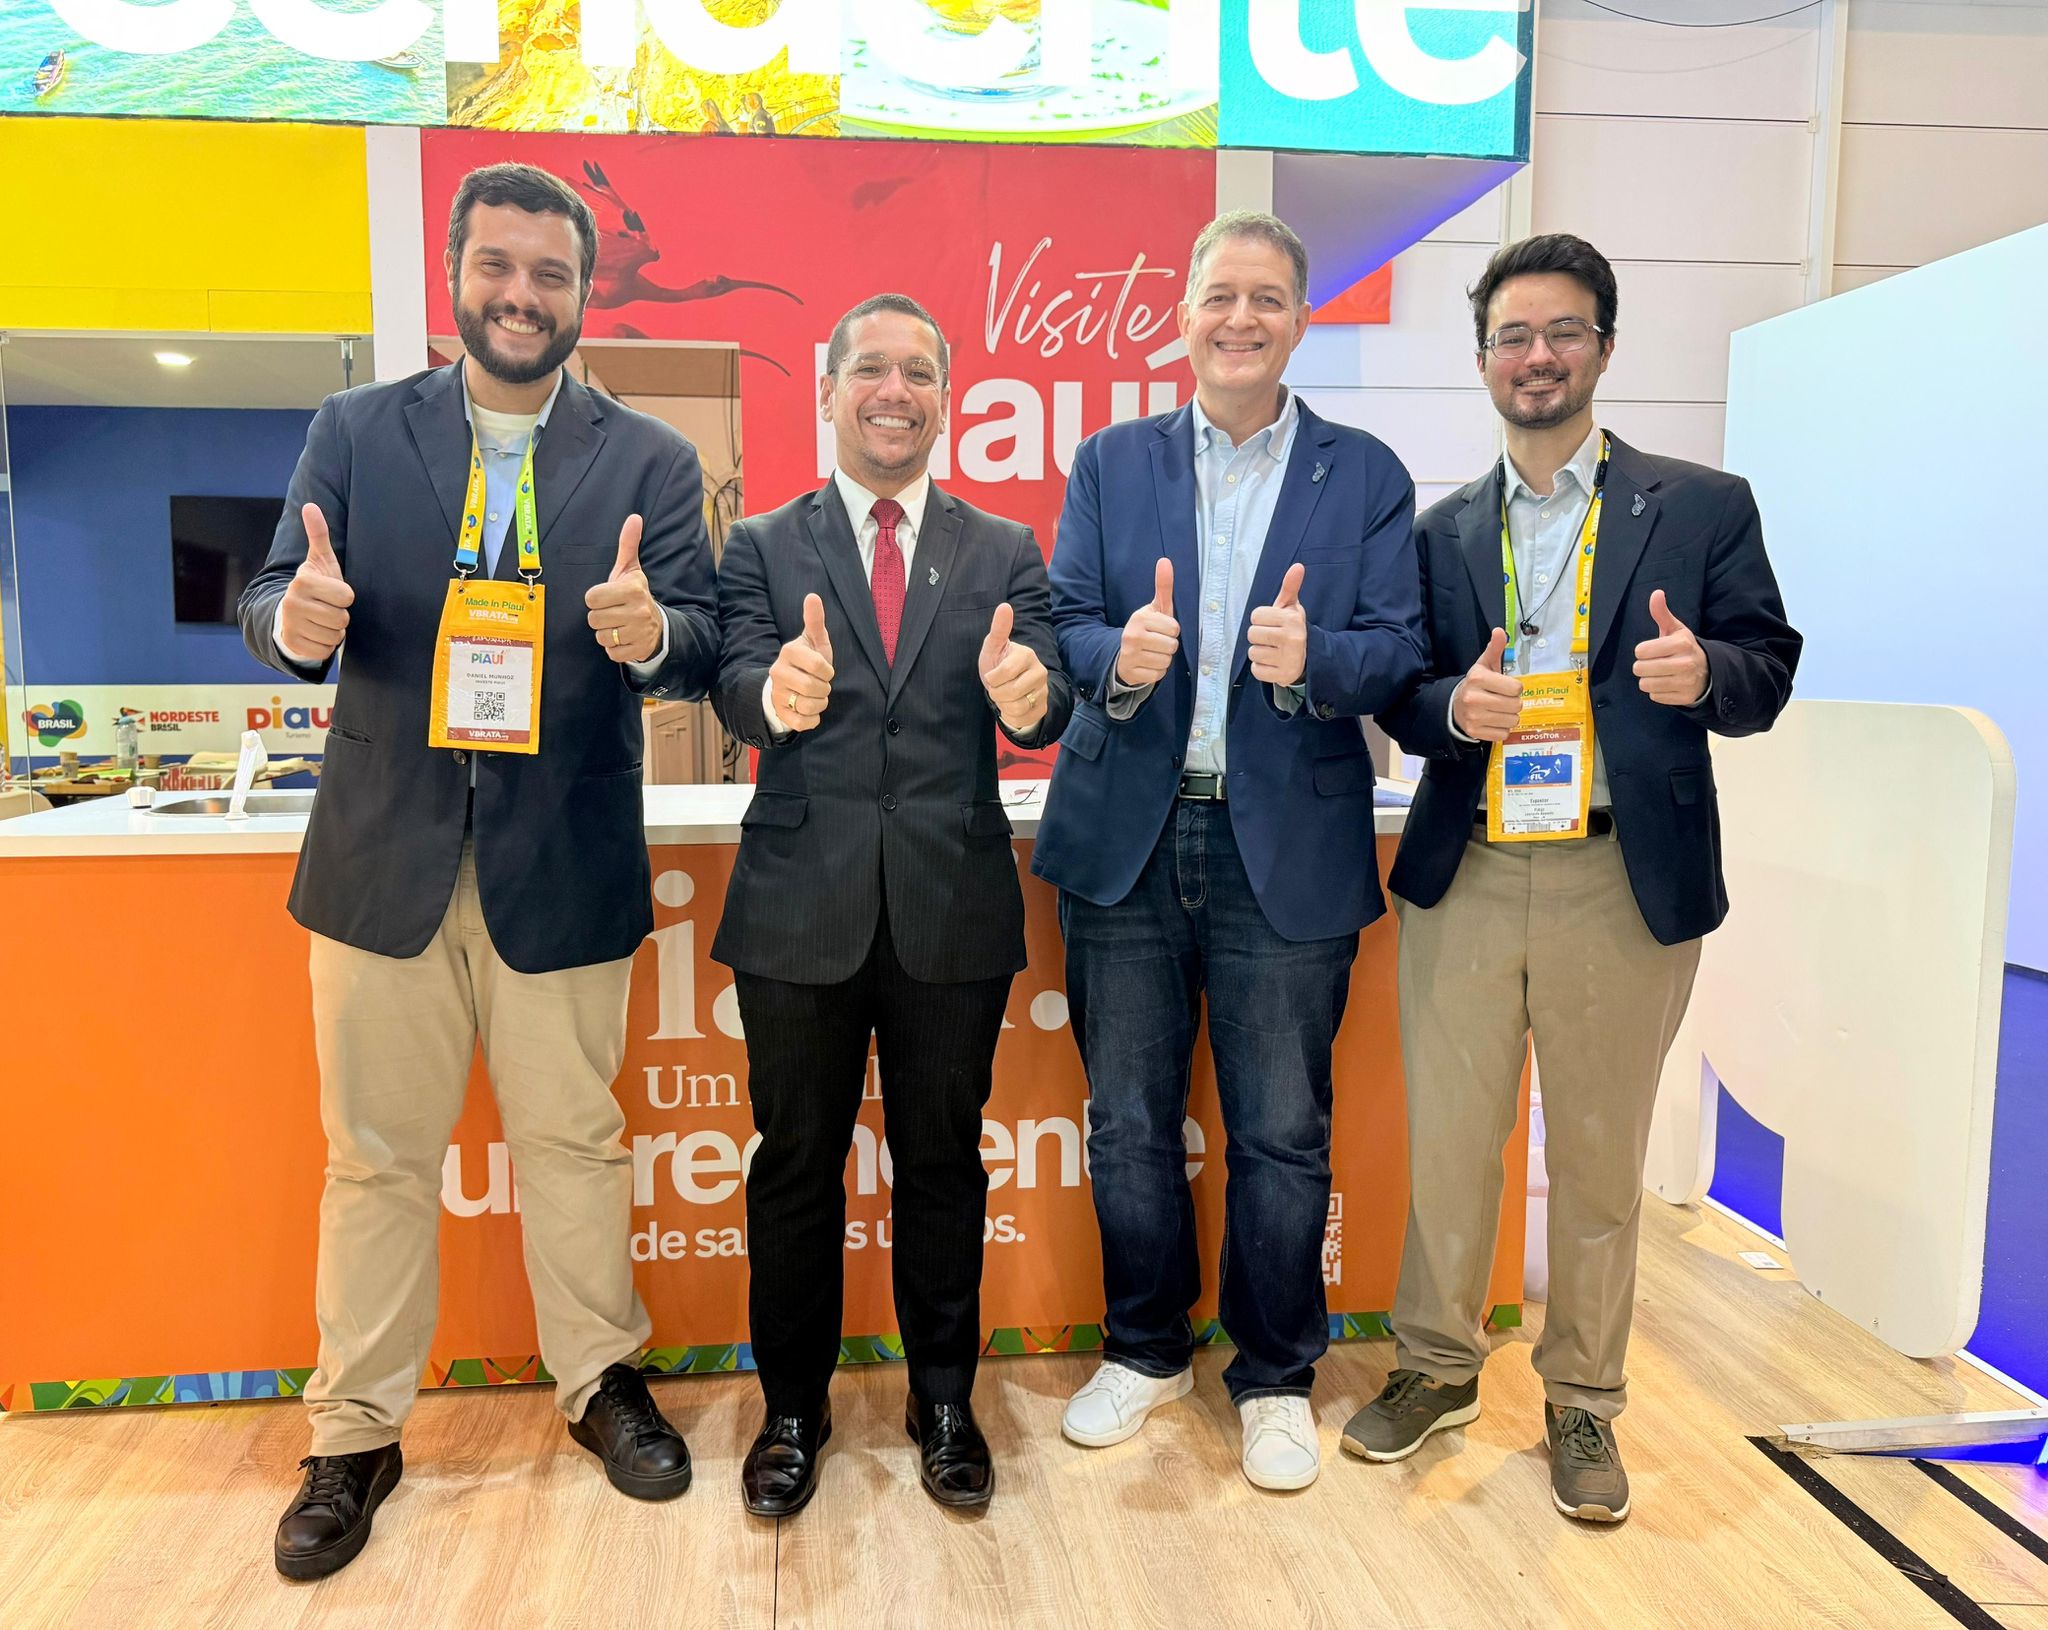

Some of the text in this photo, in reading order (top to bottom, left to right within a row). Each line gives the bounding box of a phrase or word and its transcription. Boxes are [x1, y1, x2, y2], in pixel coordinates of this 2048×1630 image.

[985, 236, 1176, 360] Visite
[465, 597, 525, 612] Made in Piauí
[471, 650, 505, 665] PIAUÍ
[1536, 688, 1545, 696] in
[1546, 686, 1570, 695] Piauí
[1522, 698, 1555, 708] BRATA
[149, 711, 220, 723] NORDESTE
[246, 695, 334, 730] piau
[38, 719, 76, 729] BRASIL
[150, 723, 182, 732] BRASIL
[1521, 732, 1560, 741] EXPOSITOR
[642, 1063, 742, 1110] Um
[630, 1221, 687, 1262] de
